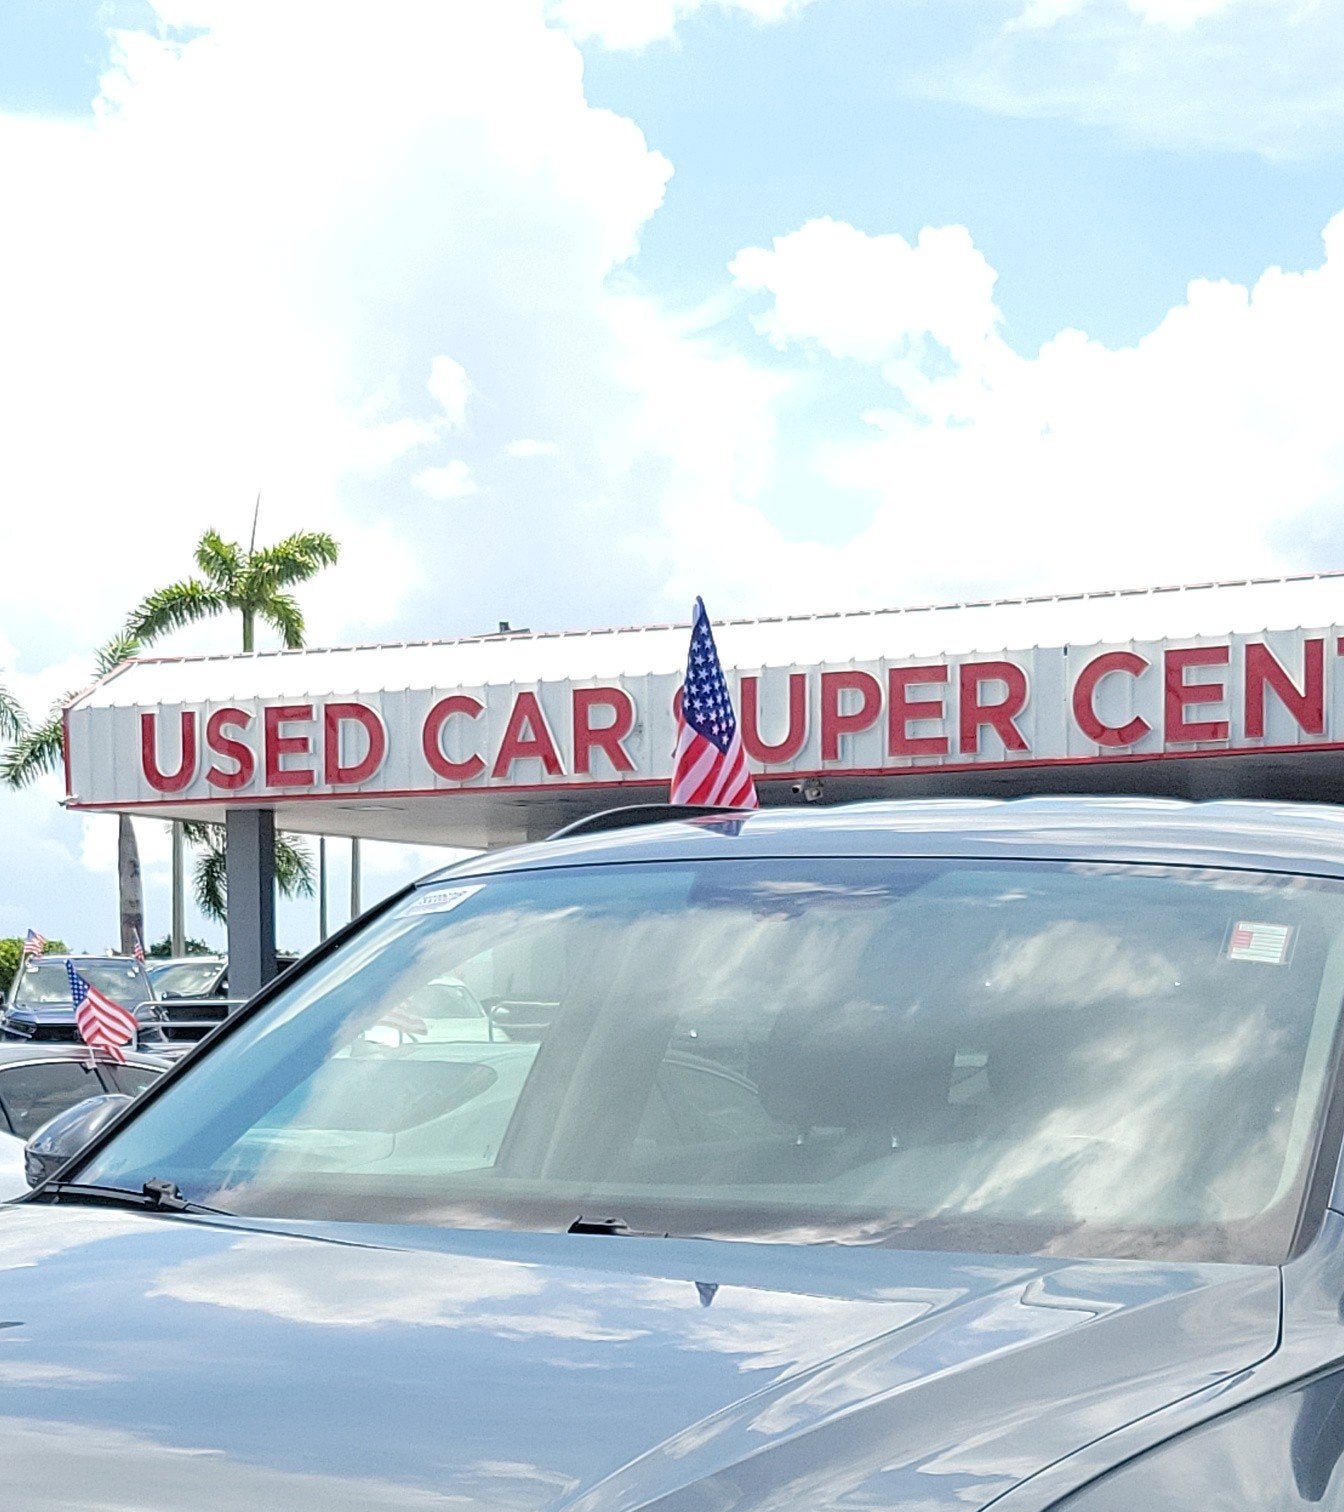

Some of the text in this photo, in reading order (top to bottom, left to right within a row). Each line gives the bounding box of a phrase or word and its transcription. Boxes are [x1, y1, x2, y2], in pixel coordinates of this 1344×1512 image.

[141, 703, 384, 793] USED
[422, 687, 635, 782] CAR
[672, 662, 1027, 764] UPER
